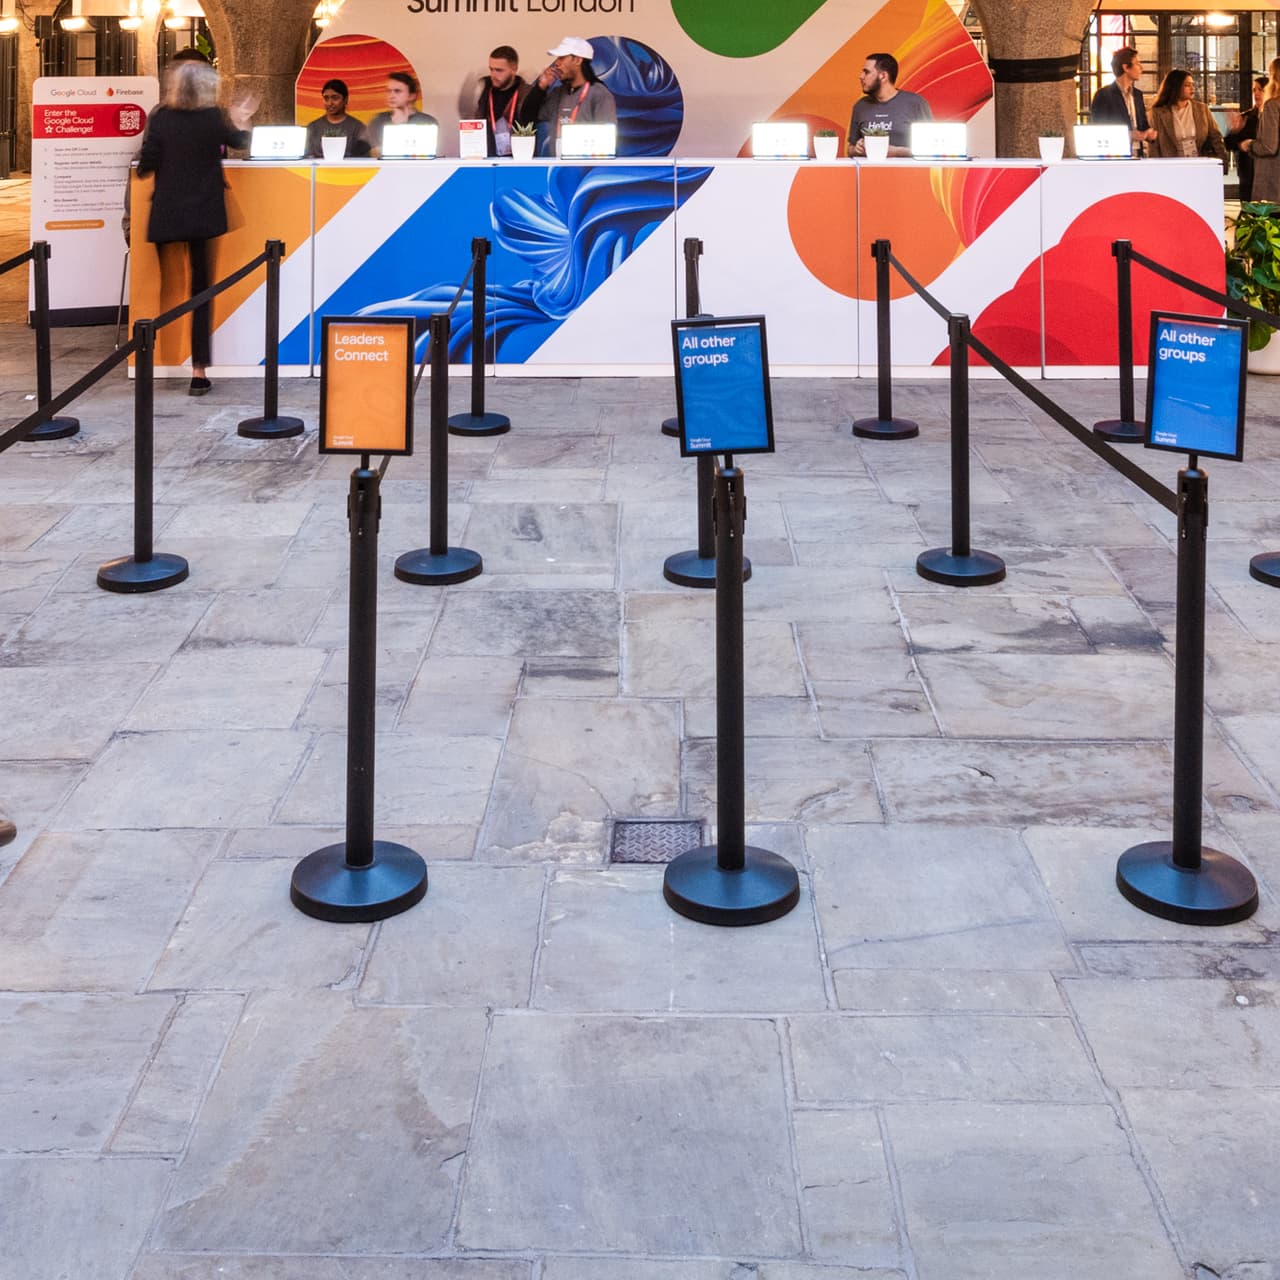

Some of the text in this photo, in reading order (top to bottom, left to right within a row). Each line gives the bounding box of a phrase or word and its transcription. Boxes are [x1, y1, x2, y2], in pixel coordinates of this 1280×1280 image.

[44, 117, 71, 125] Google
[55, 125, 94, 134] Challenge!
[334, 332, 385, 345] Leaders
[682, 336, 736, 349] All other
[1160, 329, 1216, 346] All other
[334, 348, 389, 361] Connect
[683, 353, 729, 368] groups
[1159, 347, 1206, 364] groups
